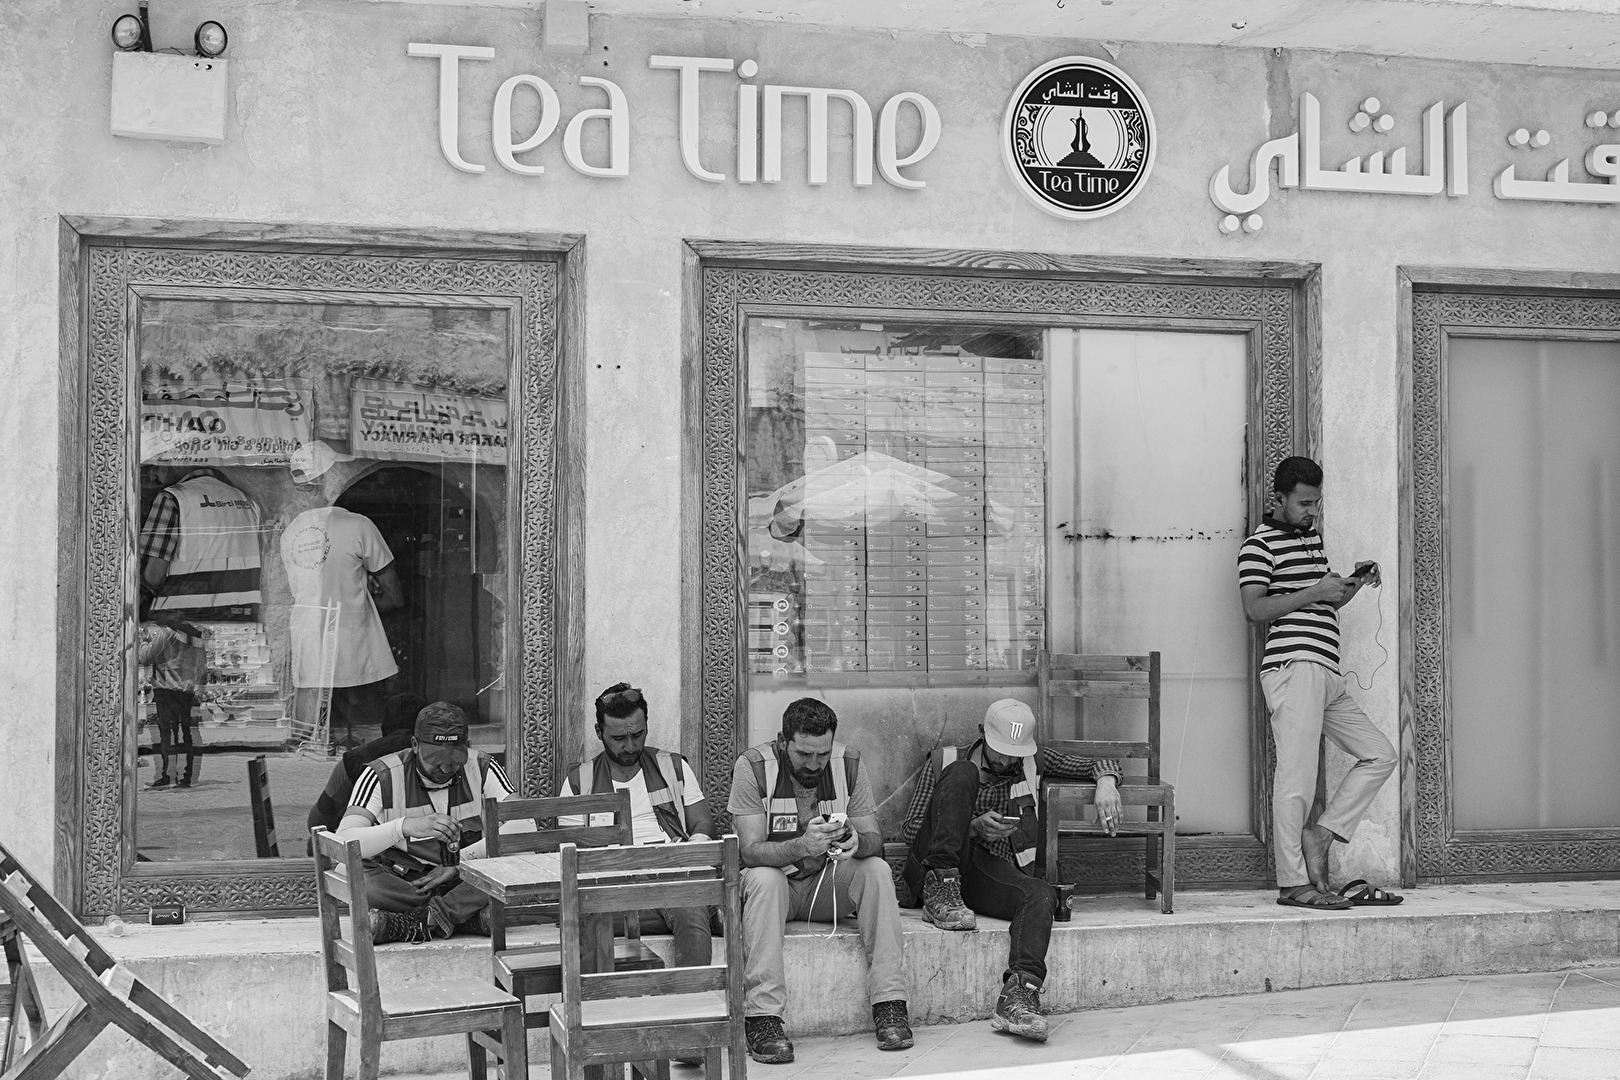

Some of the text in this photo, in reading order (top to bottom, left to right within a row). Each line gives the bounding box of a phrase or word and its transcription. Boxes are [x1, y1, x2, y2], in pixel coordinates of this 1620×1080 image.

[407, 42, 942, 189] Tea Time
[1042, 81, 1118, 105] وقت الشاي
[1039, 170, 1119, 194] Tea Time
[1209, 91, 1469, 233] الشاي
